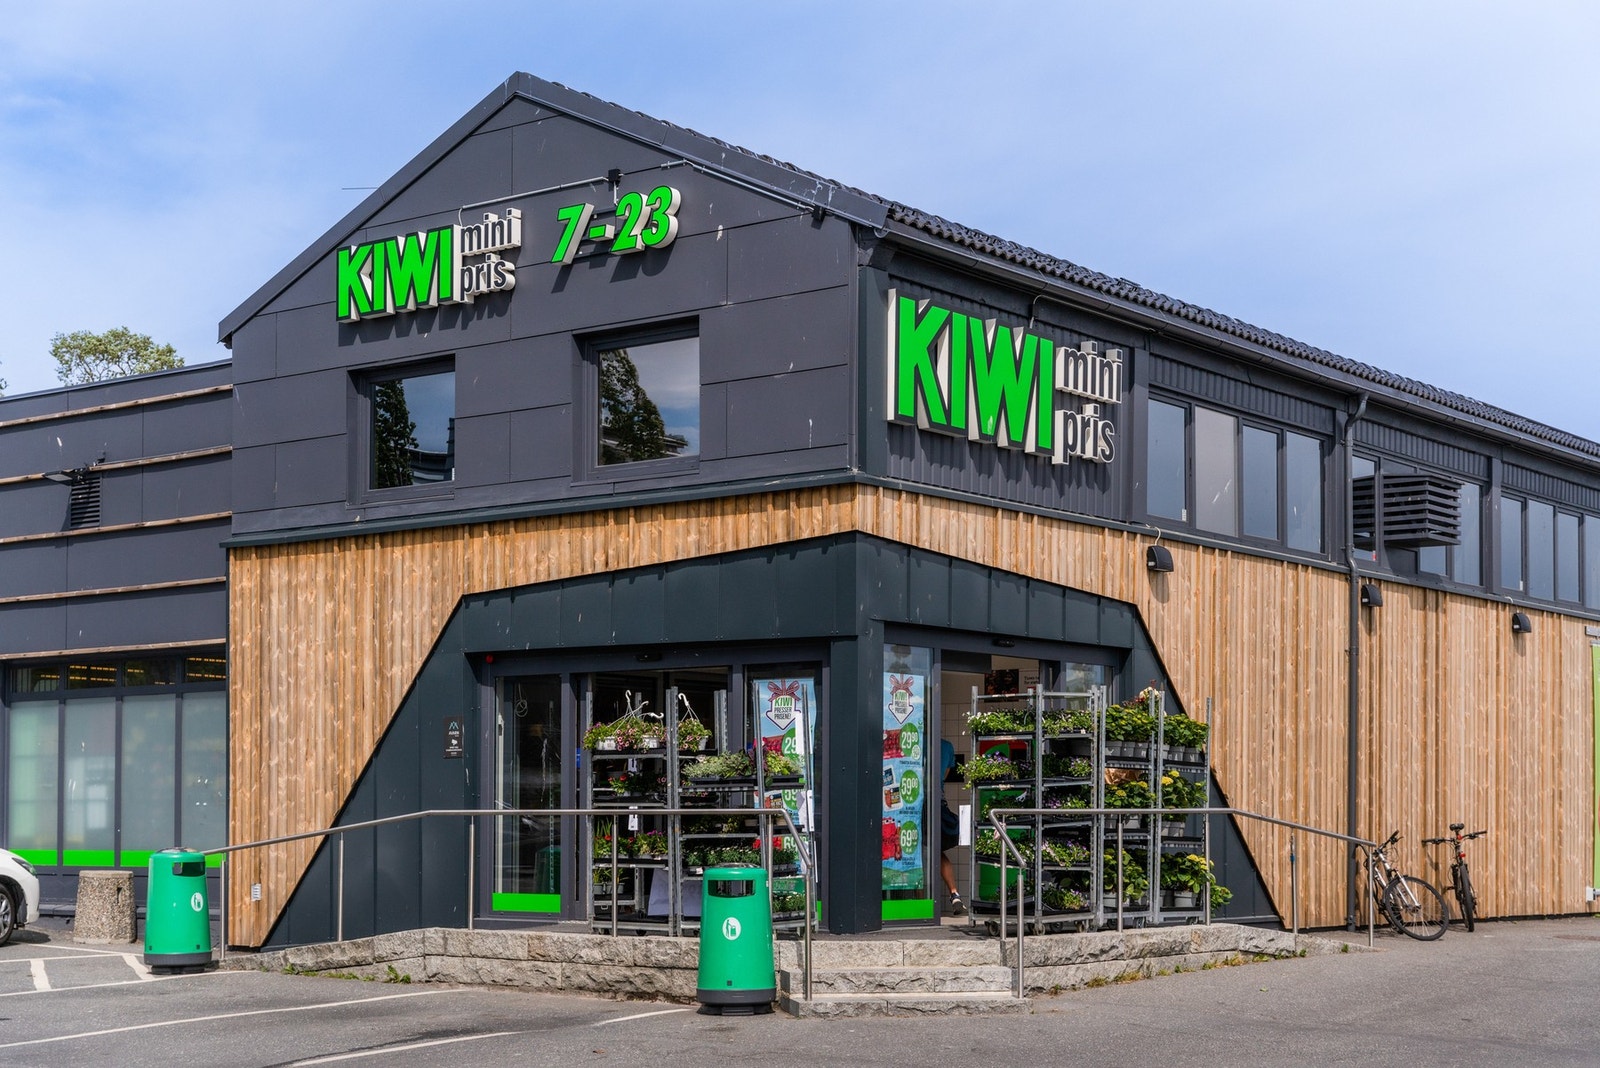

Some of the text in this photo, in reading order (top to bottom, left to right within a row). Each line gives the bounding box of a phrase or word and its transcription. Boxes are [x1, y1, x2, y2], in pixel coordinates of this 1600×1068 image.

[551, 185, 681, 265] 7-23
[336, 208, 521, 322] KIWI mini
[460, 253, 516, 303] pris
[889, 290, 1122, 457] KIWI mini
[1054, 403, 1116, 464] pris
[774, 697, 792, 707] KIWI
